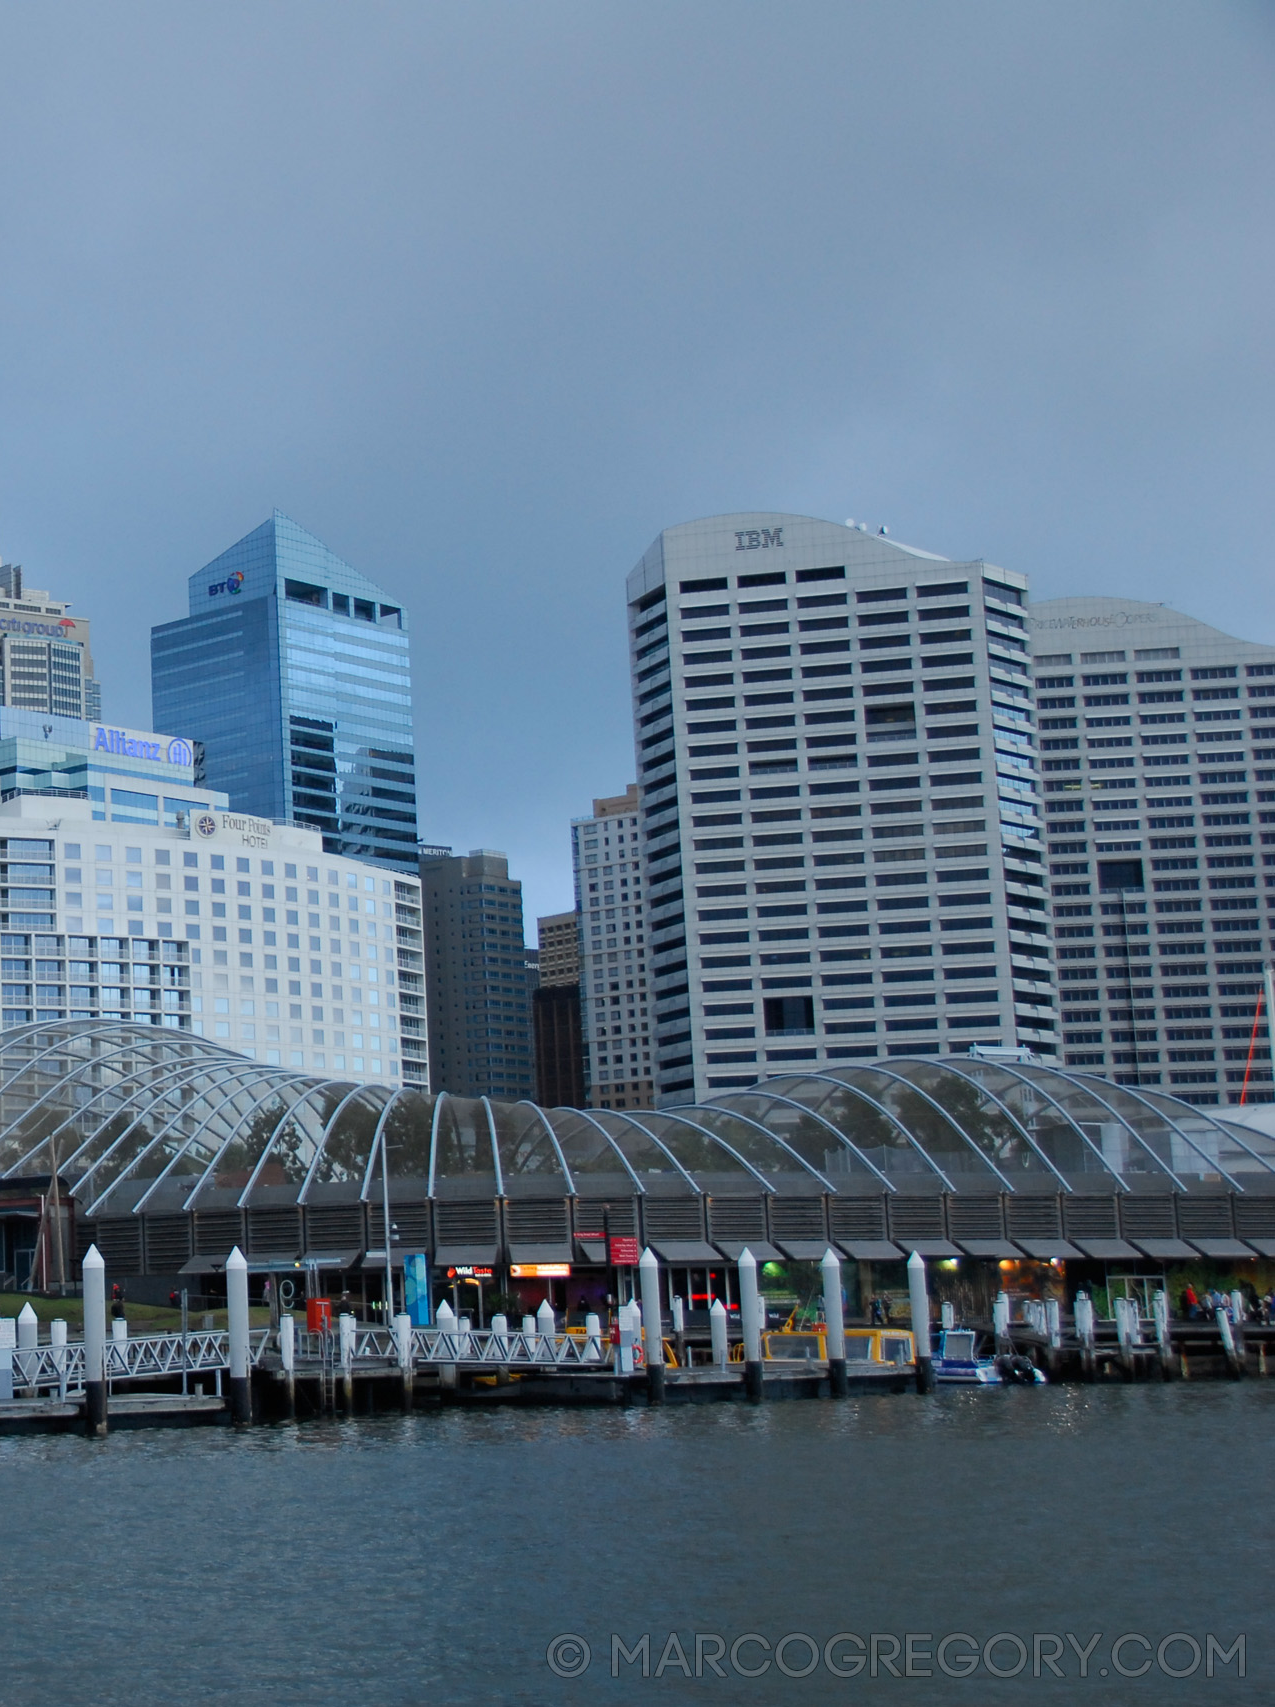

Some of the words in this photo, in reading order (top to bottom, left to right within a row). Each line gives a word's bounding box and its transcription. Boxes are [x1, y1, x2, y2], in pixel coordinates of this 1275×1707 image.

[735, 528, 784, 551] IBM
[208, 581, 227, 597] BT
[94, 727, 162, 761] Allianz
[222, 814, 247, 831] Four
[248, 818, 271, 836] Points
[455, 1266, 473, 1276] Wild
